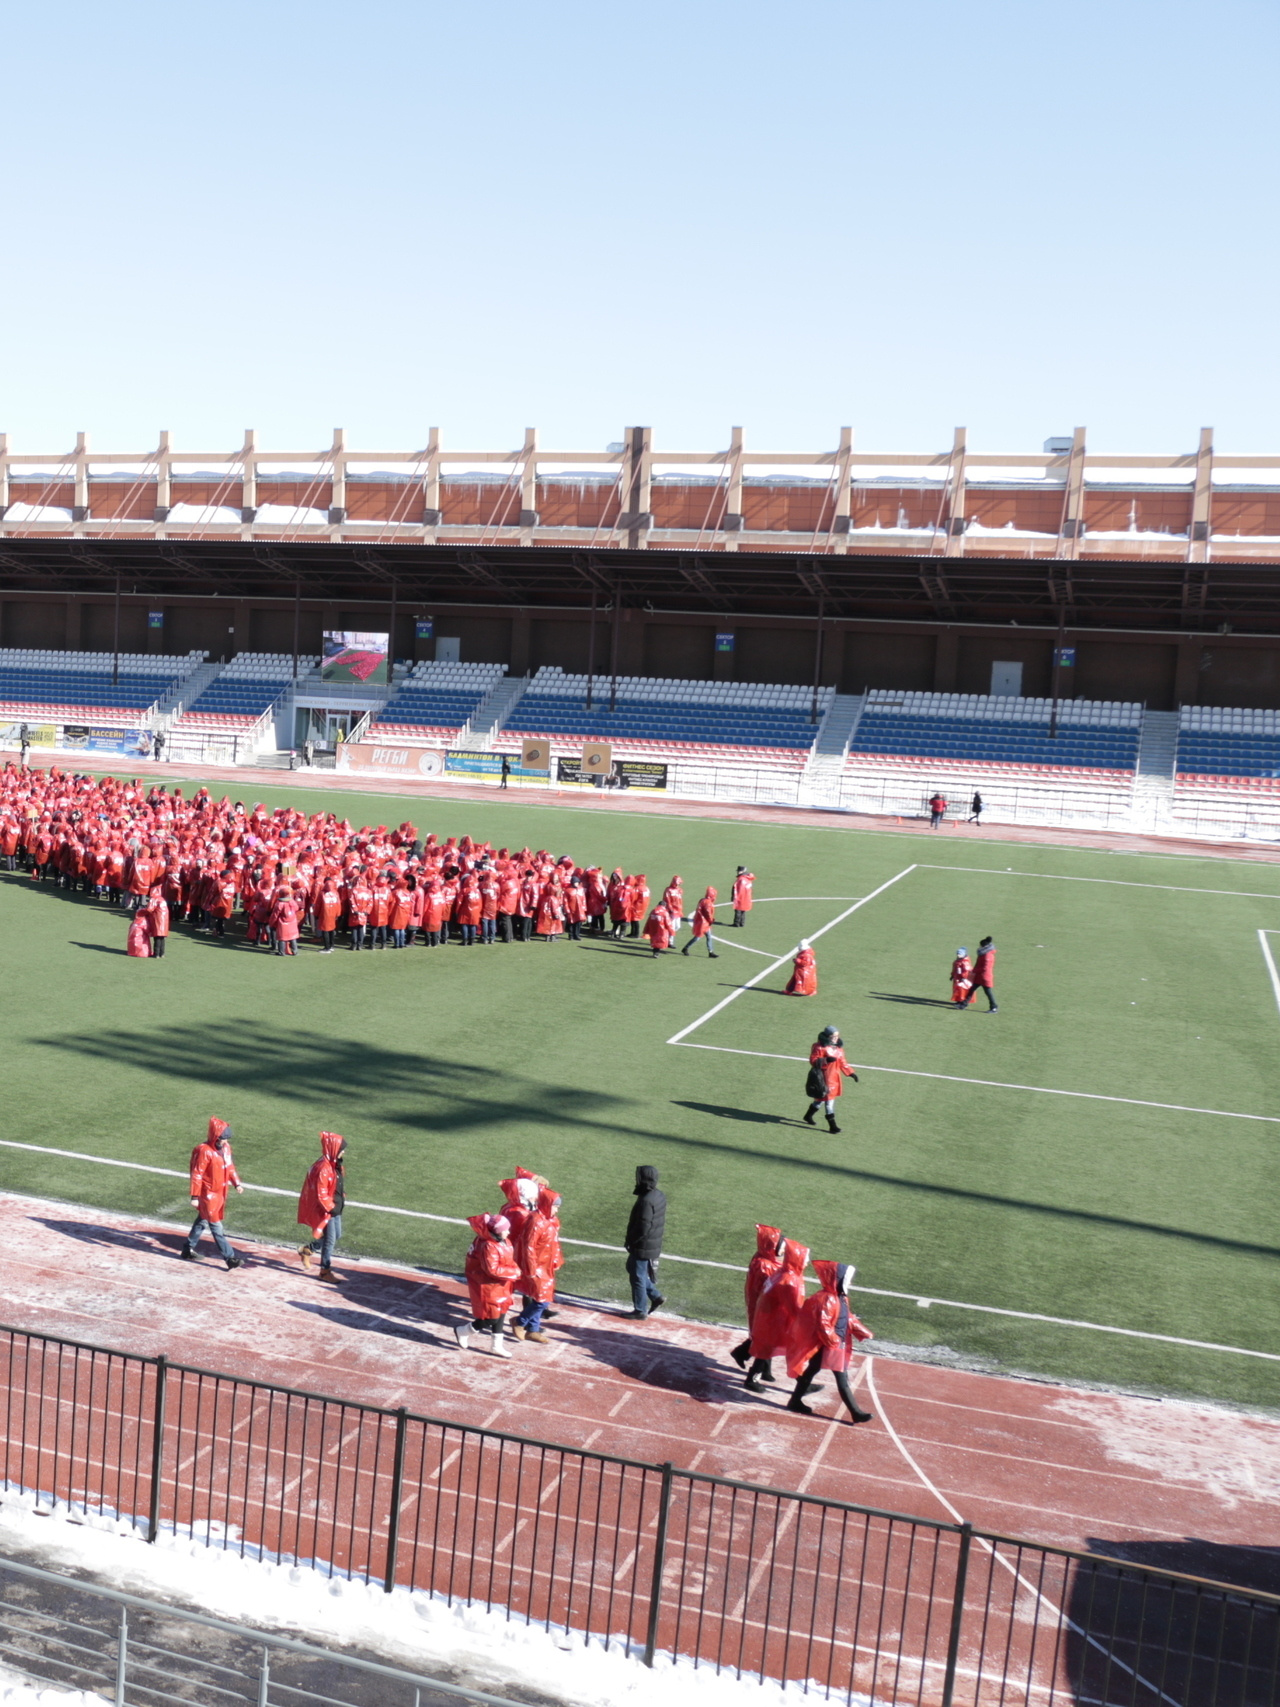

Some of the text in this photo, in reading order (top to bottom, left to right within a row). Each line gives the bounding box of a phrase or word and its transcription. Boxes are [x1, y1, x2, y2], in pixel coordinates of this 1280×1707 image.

[91, 729, 124, 739] БАССЕЙН
[371, 748, 409, 765] РЕГБИ
[448, 752, 493, 762] БАДМИНТОН
